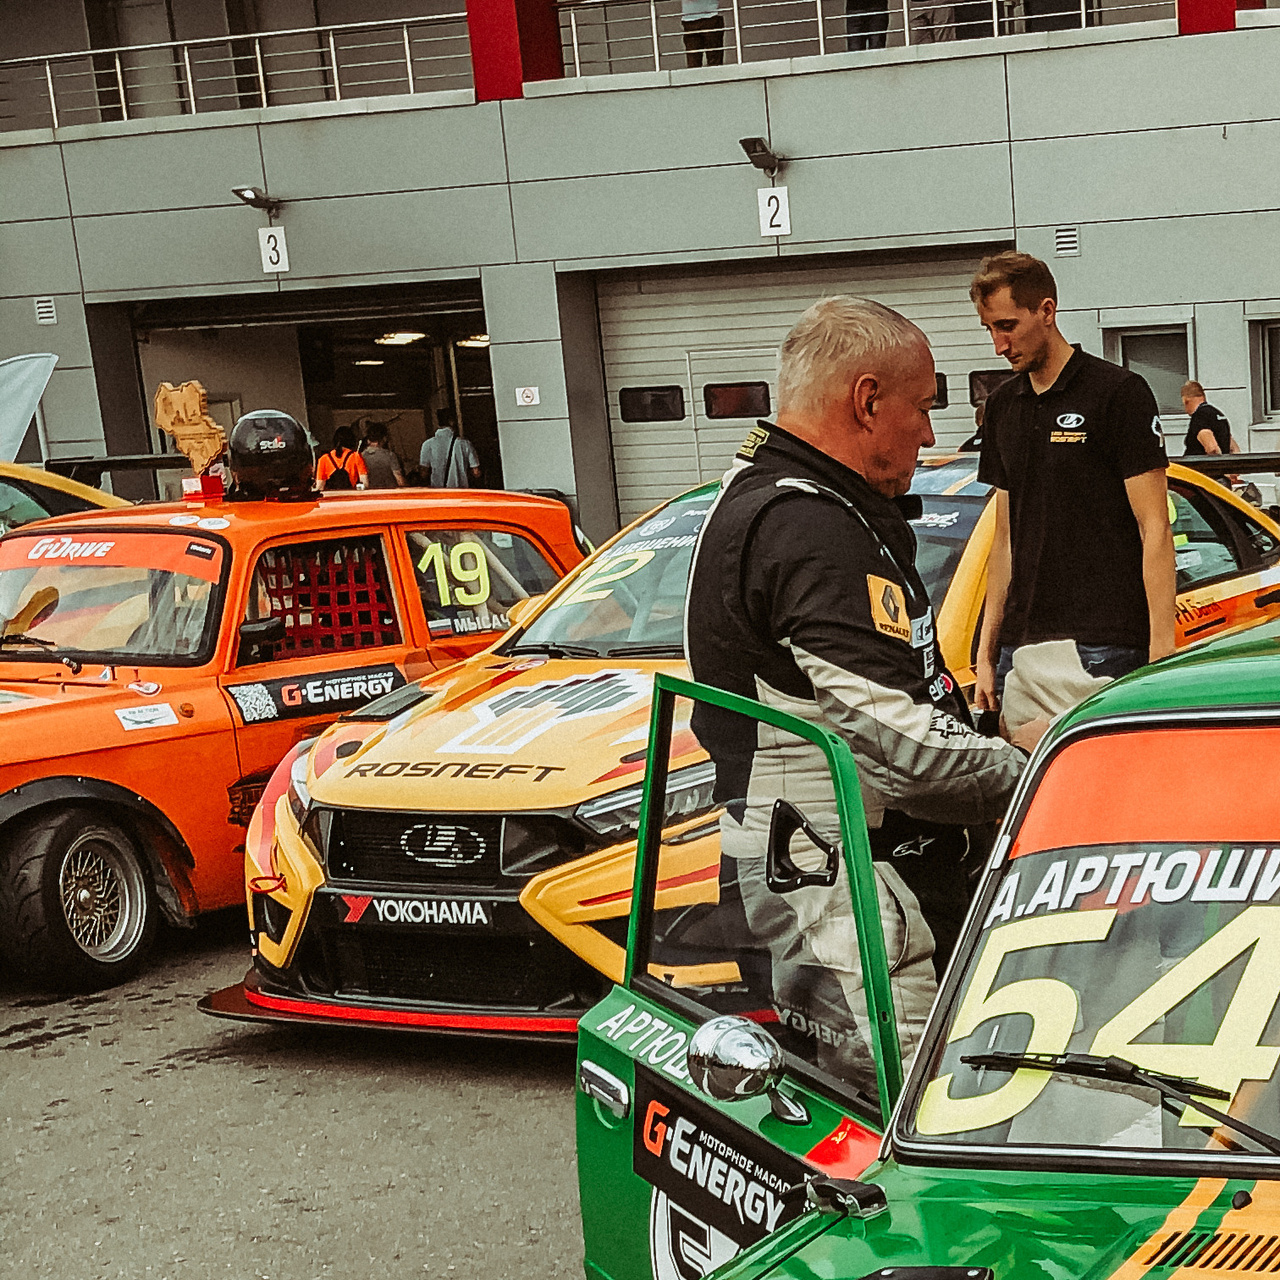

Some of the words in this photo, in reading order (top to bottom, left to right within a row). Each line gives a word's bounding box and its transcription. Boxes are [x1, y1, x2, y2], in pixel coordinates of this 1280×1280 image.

[767, 194, 782, 229] 2
[266, 233, 281, 266] 3
[416, 541, 492, 608] 19
[342, 761, 567, 783] ROSNEFT
[372, 899, 489, 925] YOKOHAMA
[595, 1003, 694, 1086] АРТЮШ
[698, 1129, 754, 1174] МОТОРНОЕ
